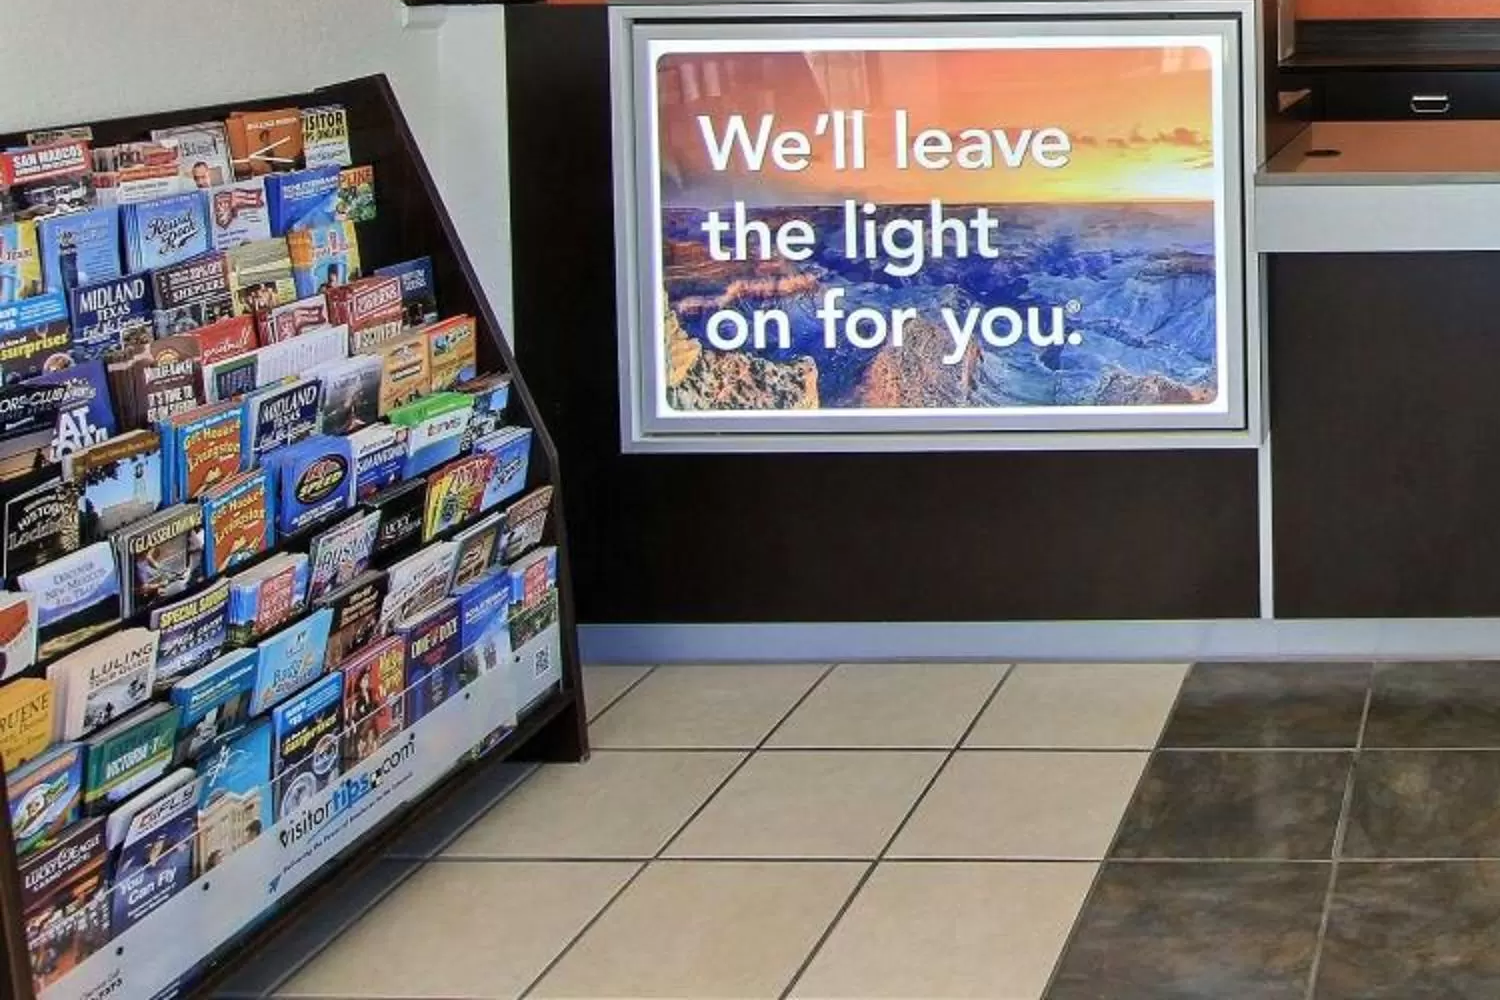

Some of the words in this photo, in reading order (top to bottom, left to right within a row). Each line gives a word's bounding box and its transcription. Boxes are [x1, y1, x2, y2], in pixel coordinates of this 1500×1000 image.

[698, 110, 865, 171] We'll
[896, 110, 1072, 169] leave
[12, 152, 38, 170] SAN
[702, 202, 815, 262] the
[844, 199, 1000, 277] light
[80, 278, 145, 314] MIDLAND
[97, 303, 132, 322] TEXAS
[706, 304, 790, 350] on
[817, 289, 917, 349] for
[0, 333, 69, 360] surprises
[260, 385, 318, 425] MIDLAND
[89, 641, 153, 681] LULING
